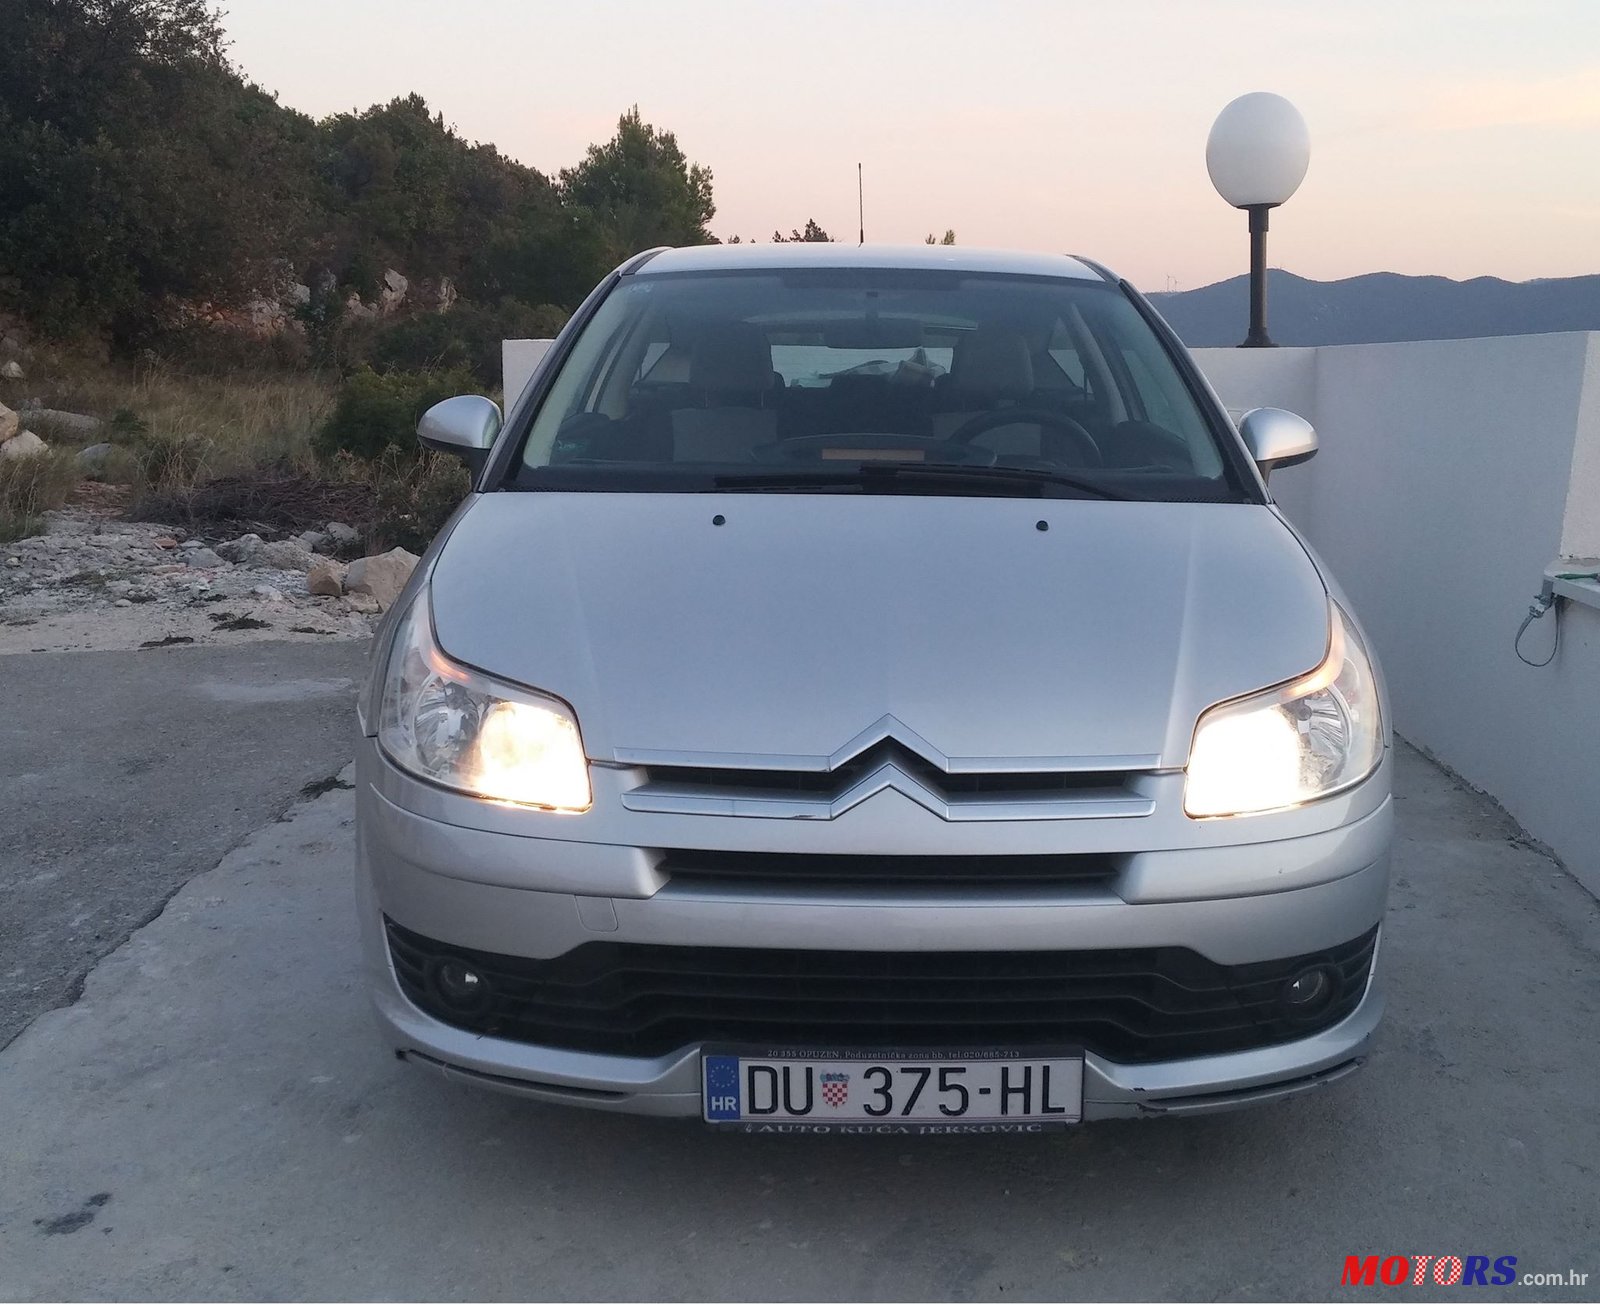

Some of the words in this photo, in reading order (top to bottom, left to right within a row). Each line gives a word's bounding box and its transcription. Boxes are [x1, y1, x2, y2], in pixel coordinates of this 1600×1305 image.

[747, 1065, 813, 1116] DU
[862, 1065, 1066, 1116] 375-HL
[711, 1096, 737, 1111] HR
[758, 1124, 831, 1134] AUTO
